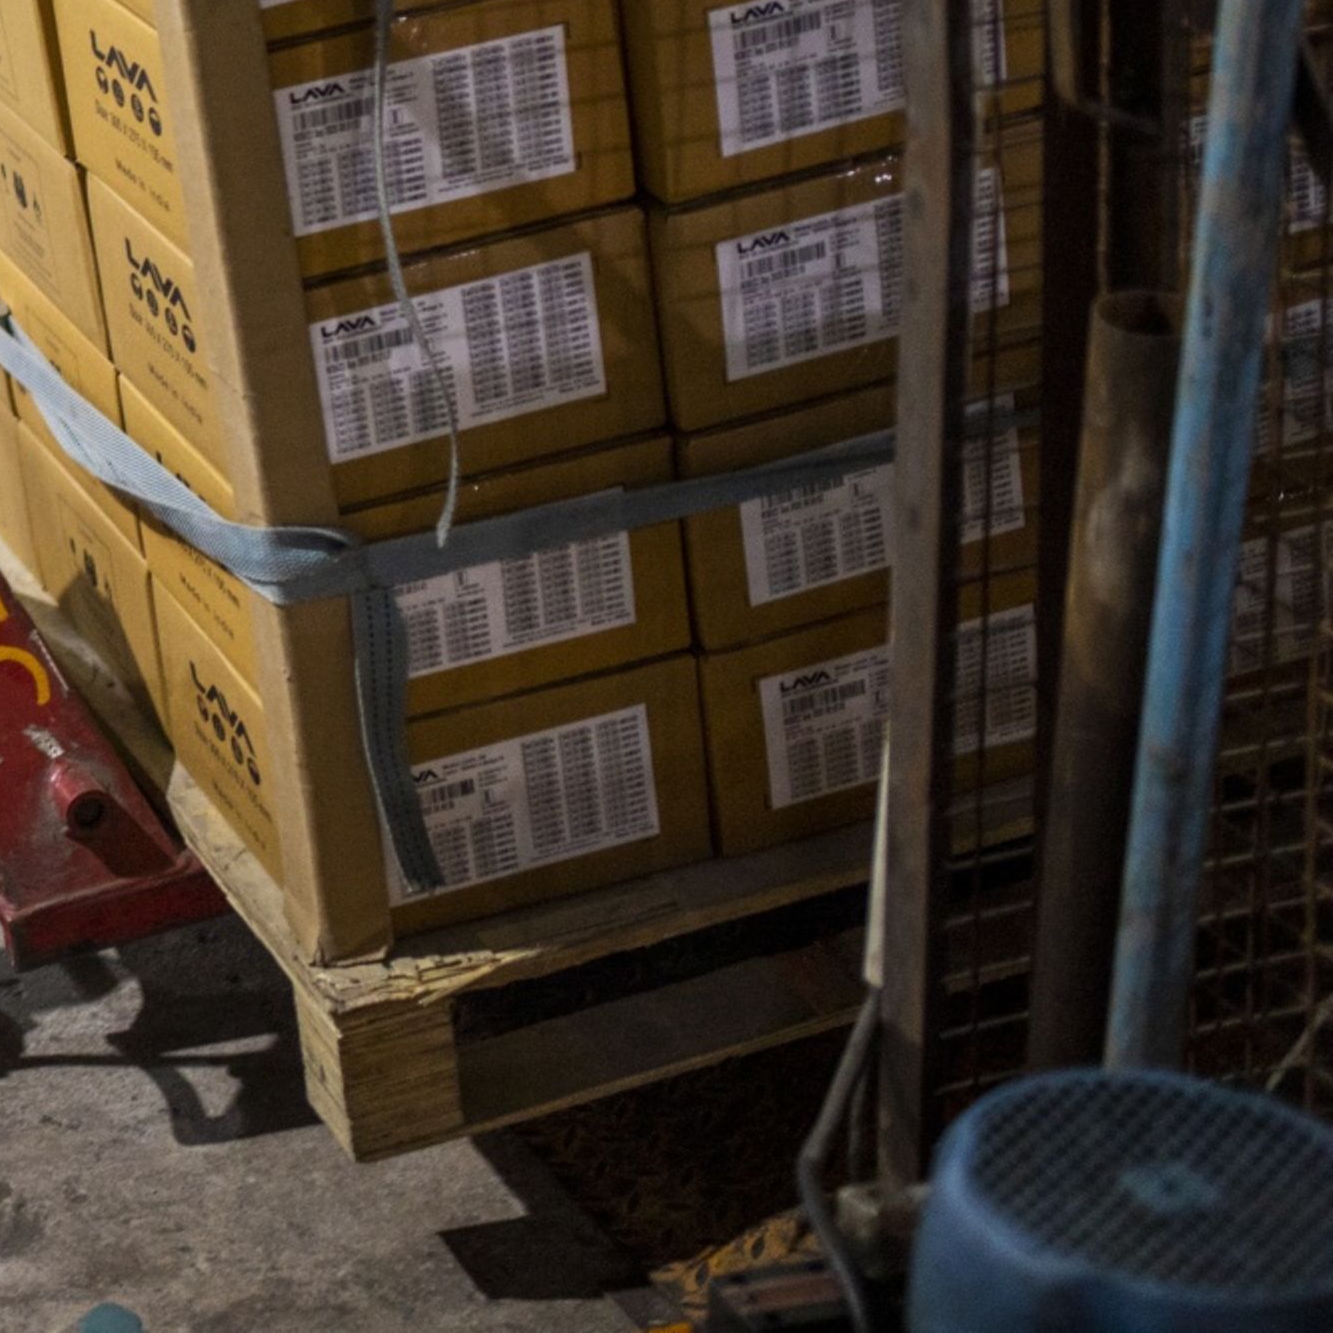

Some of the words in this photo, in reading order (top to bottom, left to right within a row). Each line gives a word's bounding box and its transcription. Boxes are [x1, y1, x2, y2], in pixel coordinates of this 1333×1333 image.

[730, 1, 784, 24] LAVA
[90, 29, 158, 103] LAVA
[290, 83, 345, 105] LAVA
[736, 231, 790, 254] LAVA
[126, 237, 193, 322] LAVA
[321, 315, 376, 338] LAVA
[779, 670, 831, 693] LAVA
[190, 660, 256, 758] LAVA
